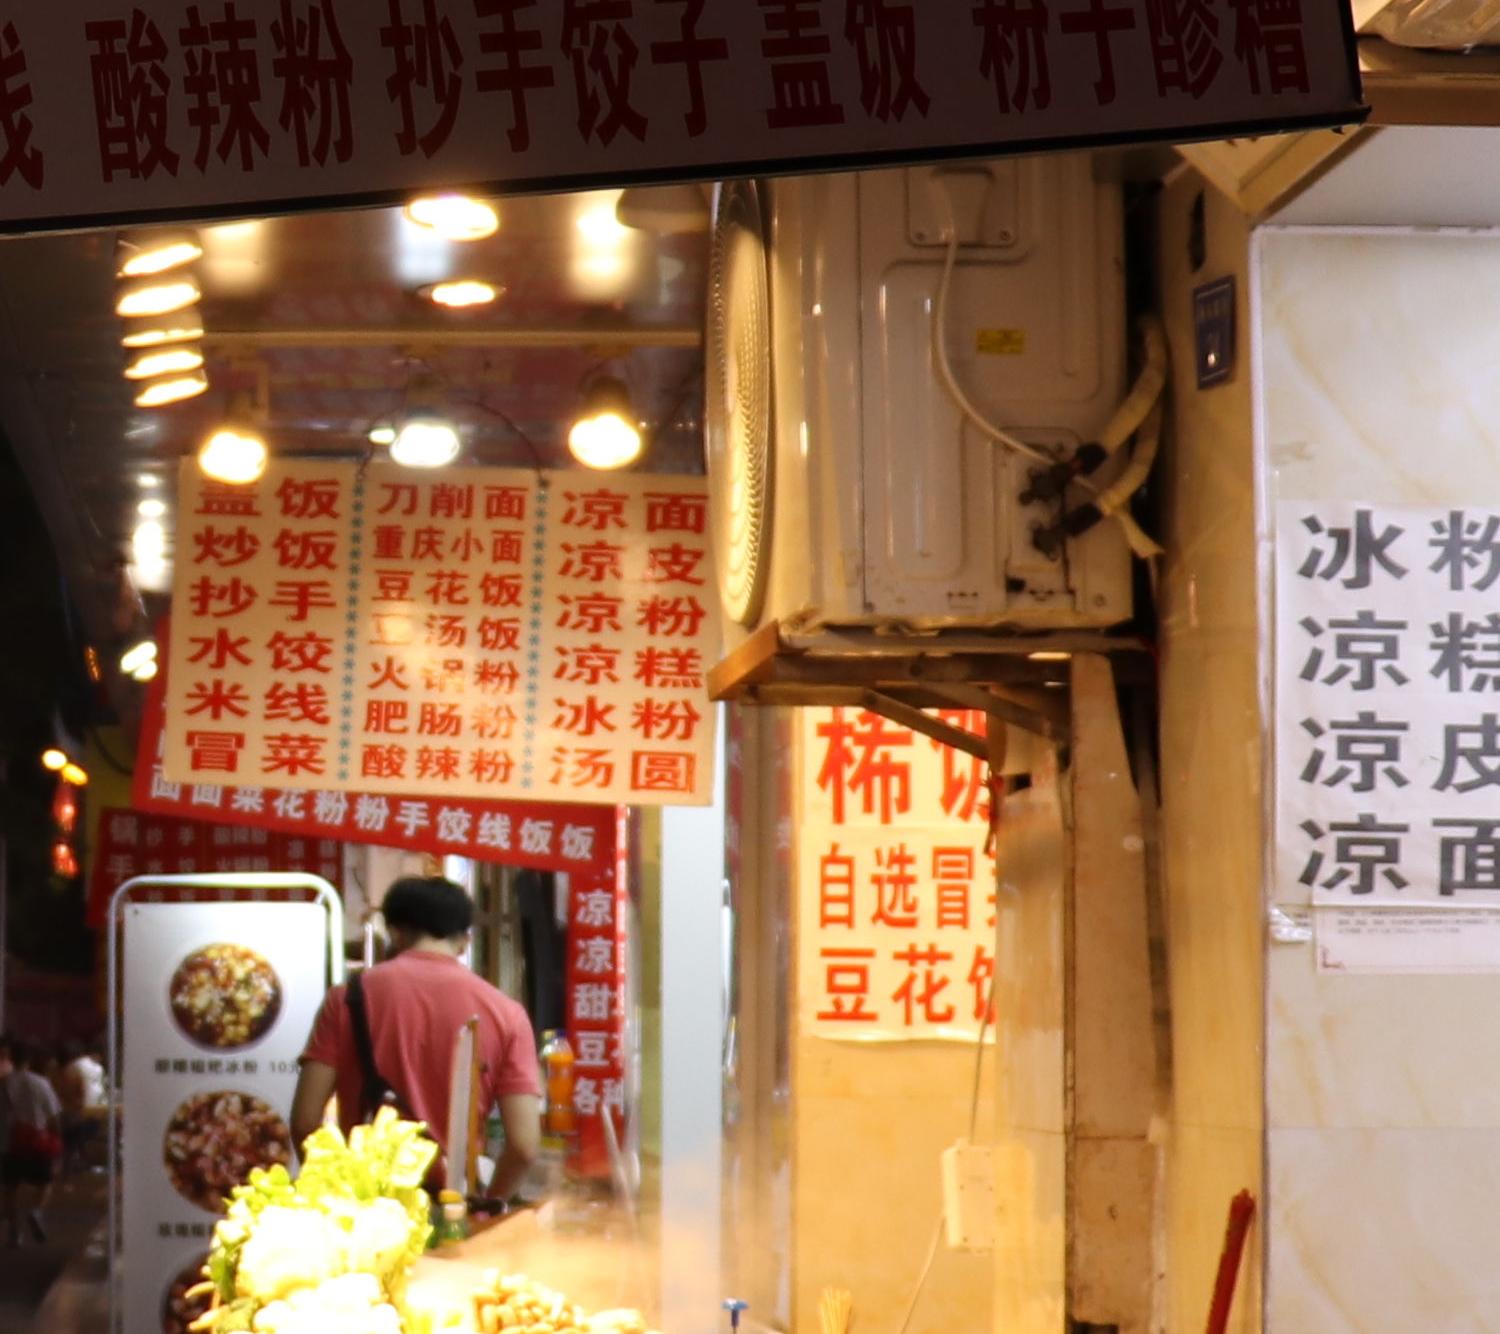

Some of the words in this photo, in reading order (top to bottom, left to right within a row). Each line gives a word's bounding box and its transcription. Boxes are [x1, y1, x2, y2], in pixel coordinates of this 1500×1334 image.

[376, 482, 529, 521] 刀削面
[560, 488, 710, 535] 凉面
[192, 524, 339, 570] 炒饭
[372, 524, 525, 564] 重庆小面
[557, 540, 705, 587] 凉皮
[189, 575, 337, 622] 抄手
[370, 569, 524, 608] 豆花饭
[555, 591, 706, 637] 凉粉
[186, 627, 335, 673] 水饺
[553, 643, 703, 689] 凉糕
[184, 678, 331, 725] 米线
[363, 699, 517, 739] 肥肠粉
[550, 694, 702, 742] 冰粉
[185, 730, 328, 776] 冒菜
[360, 744, 514, 784] 酸辣粉
[548, 746, 697, 794] 汤圆
[818, 842, 997, 931] 自选冒
